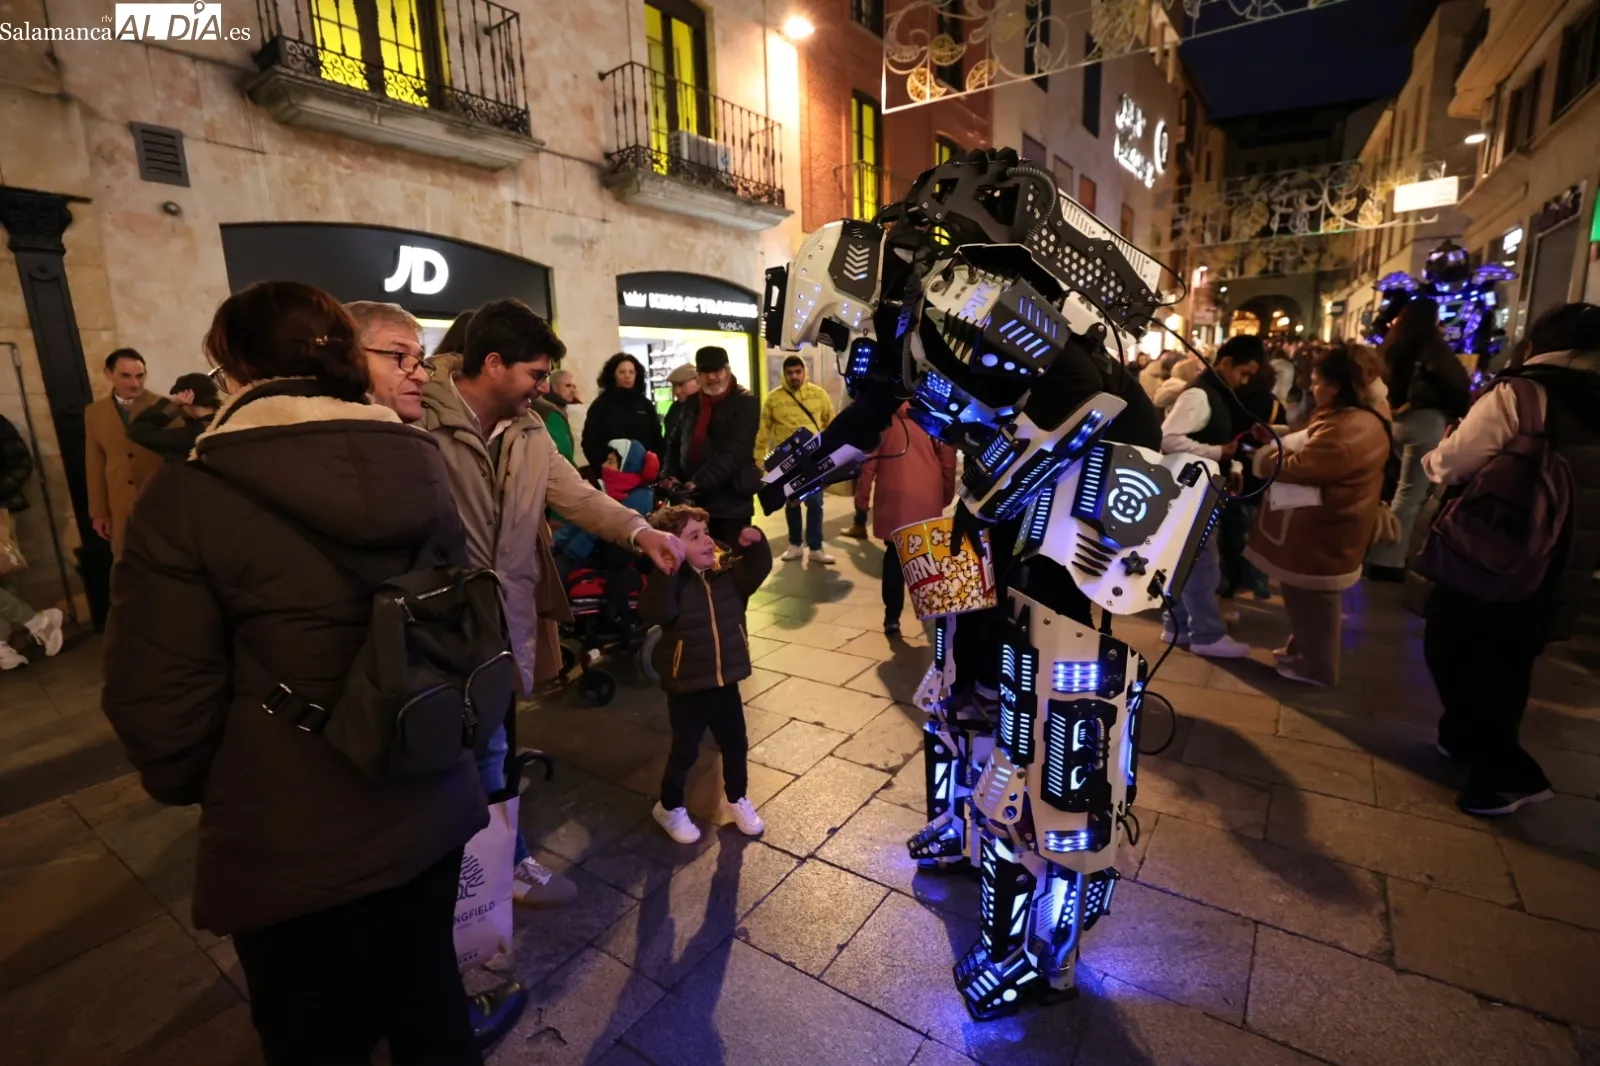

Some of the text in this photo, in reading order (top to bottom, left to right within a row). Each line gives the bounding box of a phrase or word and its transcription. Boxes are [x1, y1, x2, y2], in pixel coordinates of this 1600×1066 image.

[384, 245, 449, 295] JD
[902, 554, 940, 587] ORN
[453, 901, 495, 923] NGFIELD
